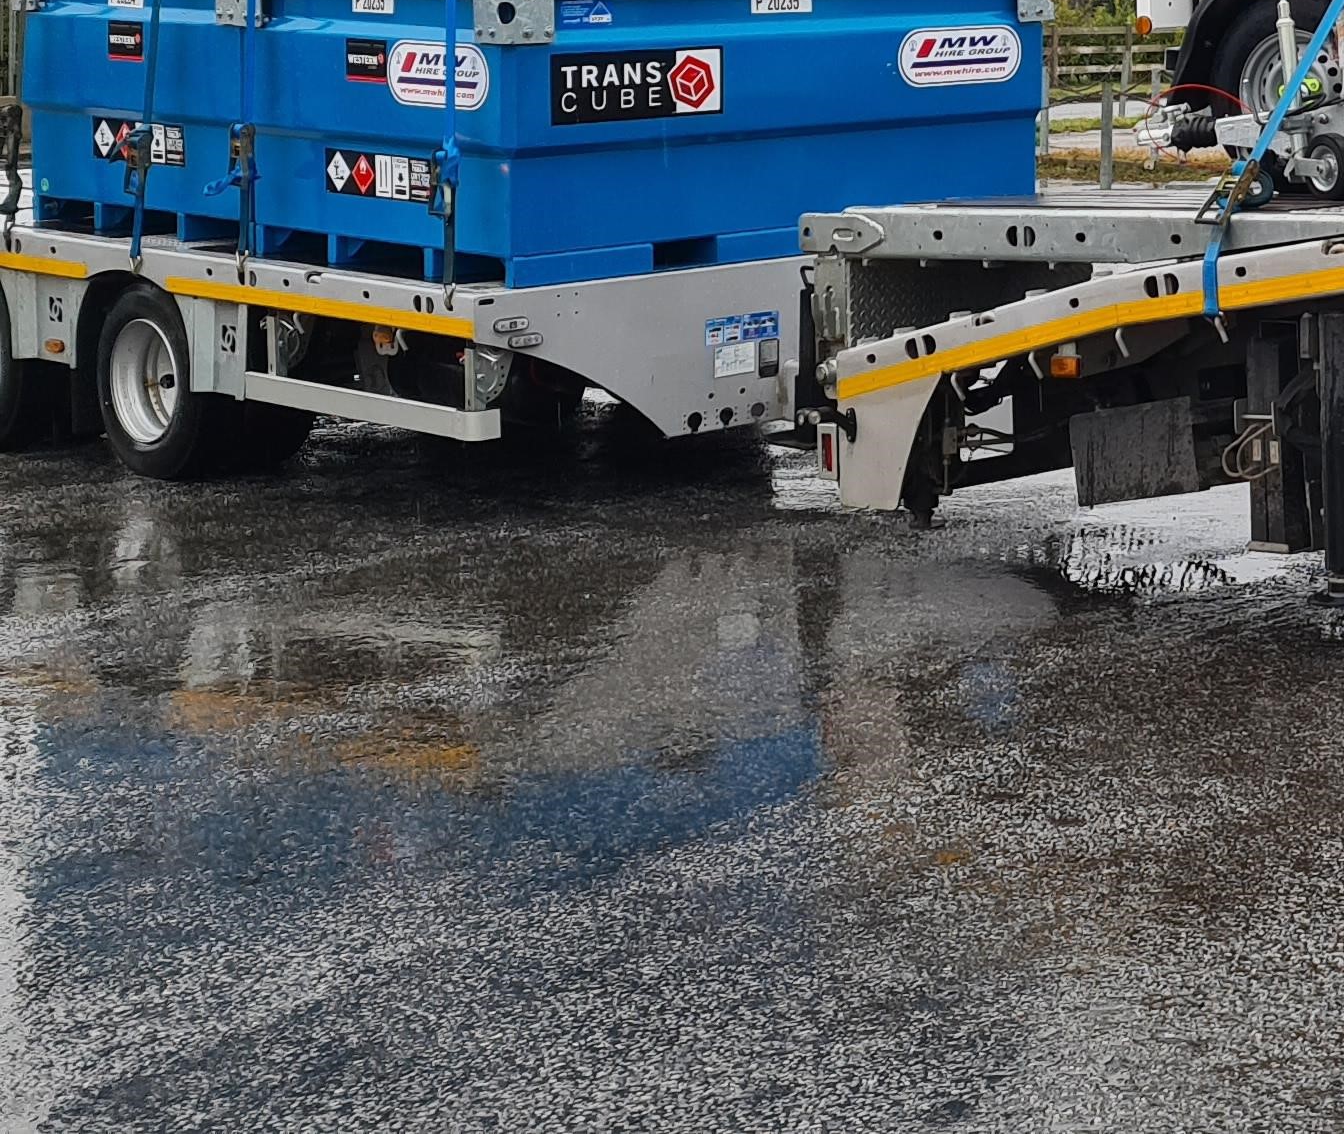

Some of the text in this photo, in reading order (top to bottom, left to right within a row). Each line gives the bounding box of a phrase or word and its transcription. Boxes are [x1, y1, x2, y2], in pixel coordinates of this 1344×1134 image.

[939, 34, 999, 49] MW
[934, 47, 1011, 58] HIRE GROUP
[415, 67, 441, 76] HIRE
[560, 61, 662, 89] TRANS
[915, 66, 1006, 78] www.mwhire.com
[561, 86, 662, 113] CUBE
